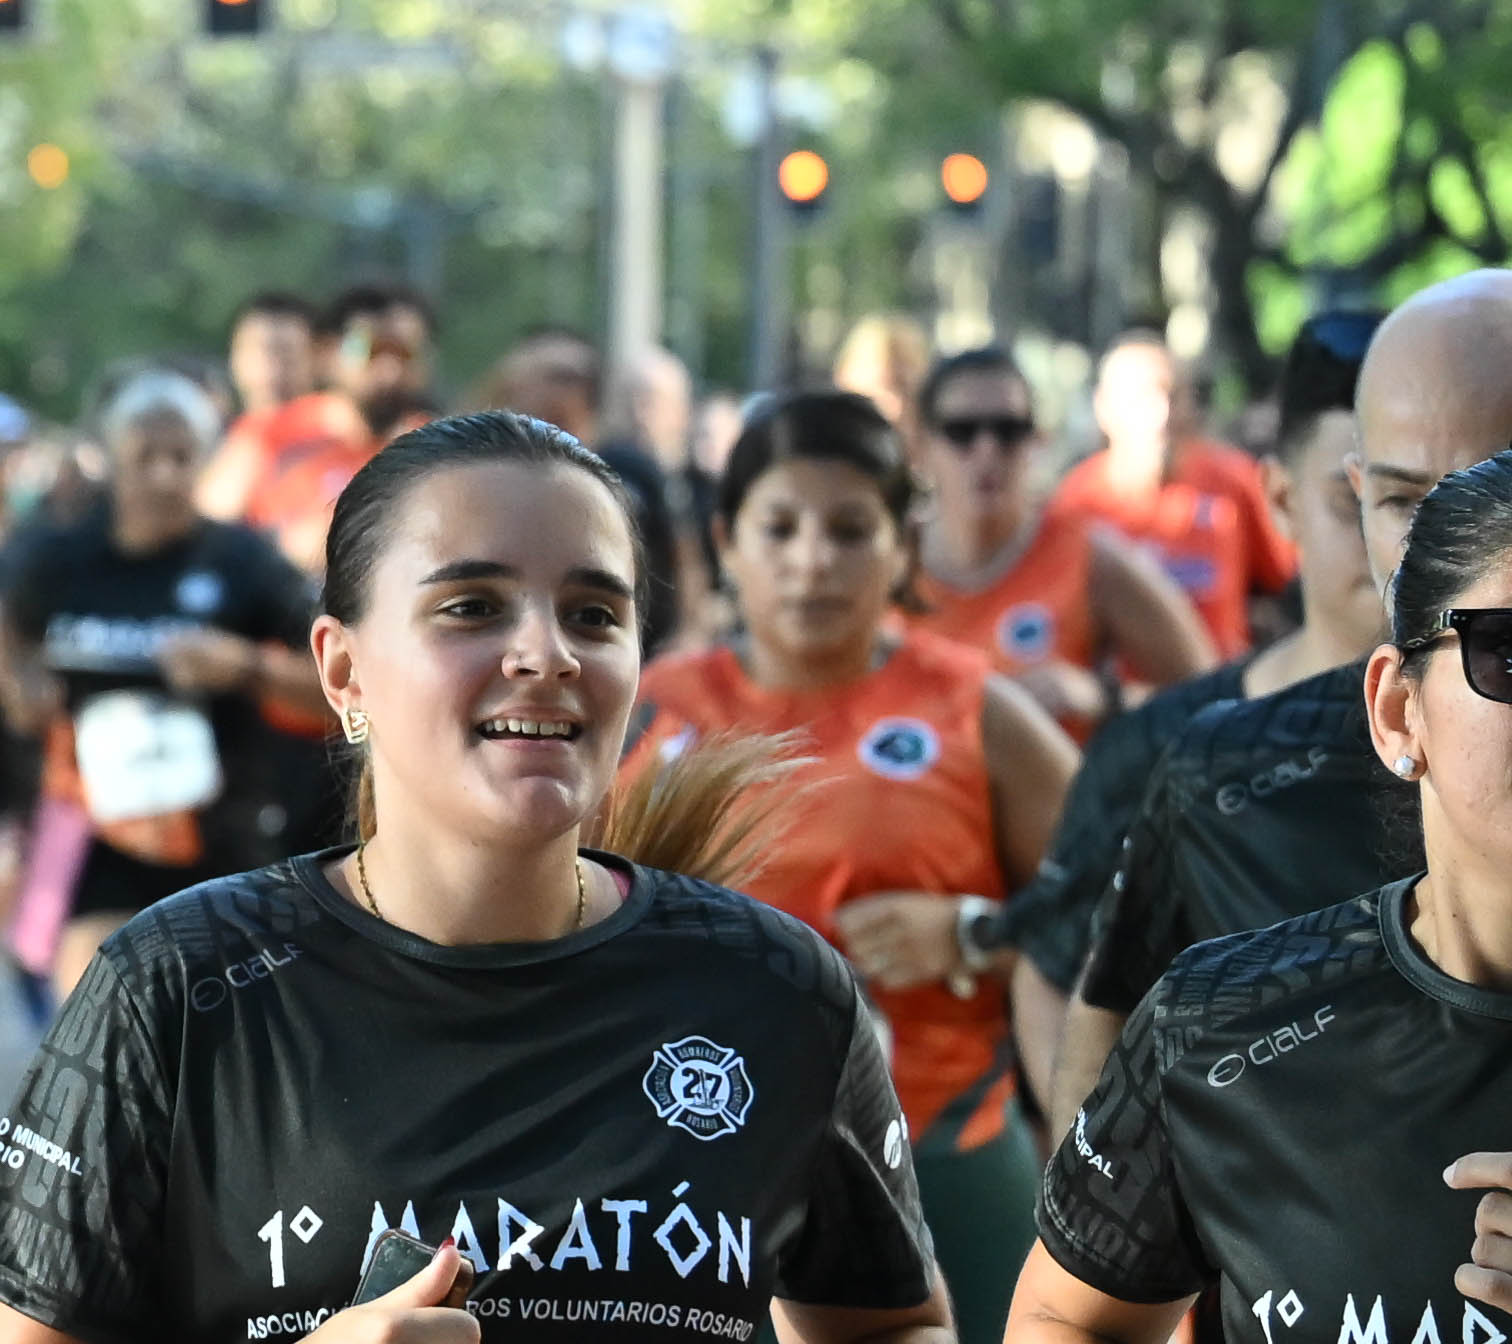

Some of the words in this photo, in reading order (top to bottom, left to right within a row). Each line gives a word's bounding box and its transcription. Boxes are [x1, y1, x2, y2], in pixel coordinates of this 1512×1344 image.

[681, 1066, 723, 1099] 27
[11, 1124, 83, 1177] MUNICIPAL
[519, 1297, 681, 1328] VOLUNTARIOS
[684, 1307, 753, 1343] ROSARIO
